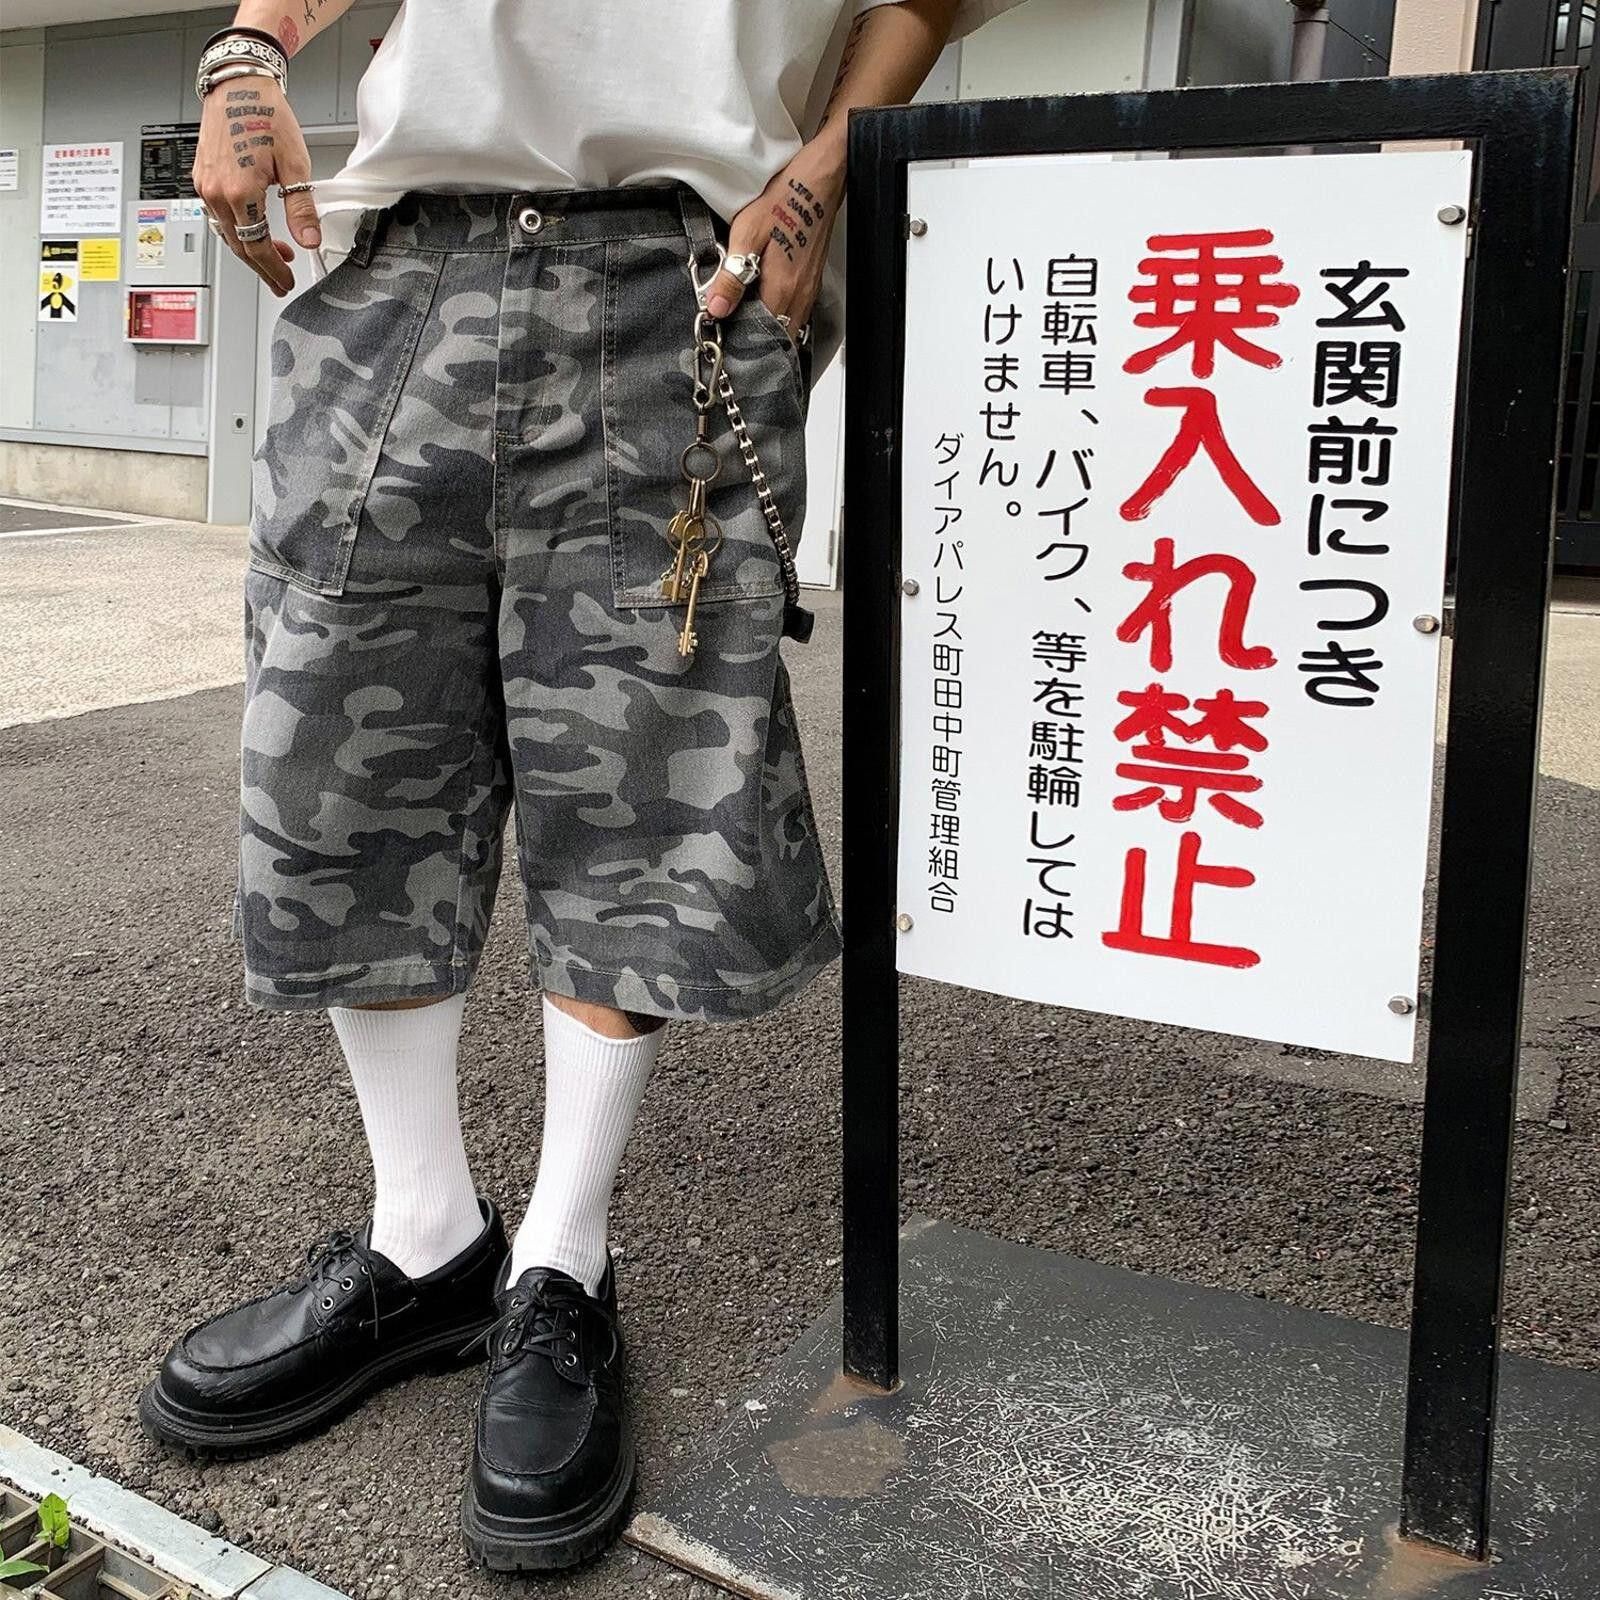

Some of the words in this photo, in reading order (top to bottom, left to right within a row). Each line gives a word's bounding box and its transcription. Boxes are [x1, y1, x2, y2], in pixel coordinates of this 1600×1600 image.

[978, 256, 1024, 518] いけません。
[1023, 253, 1099, 939] 自転車、バイク、等を駐輪しては
[1102, 228, 1300, 969] 乗入れ禁止
[1298, 259, 1410, 707] 玄関前につき
[927, 431, 964, 914] ダイアパレス町田中町管理組合
